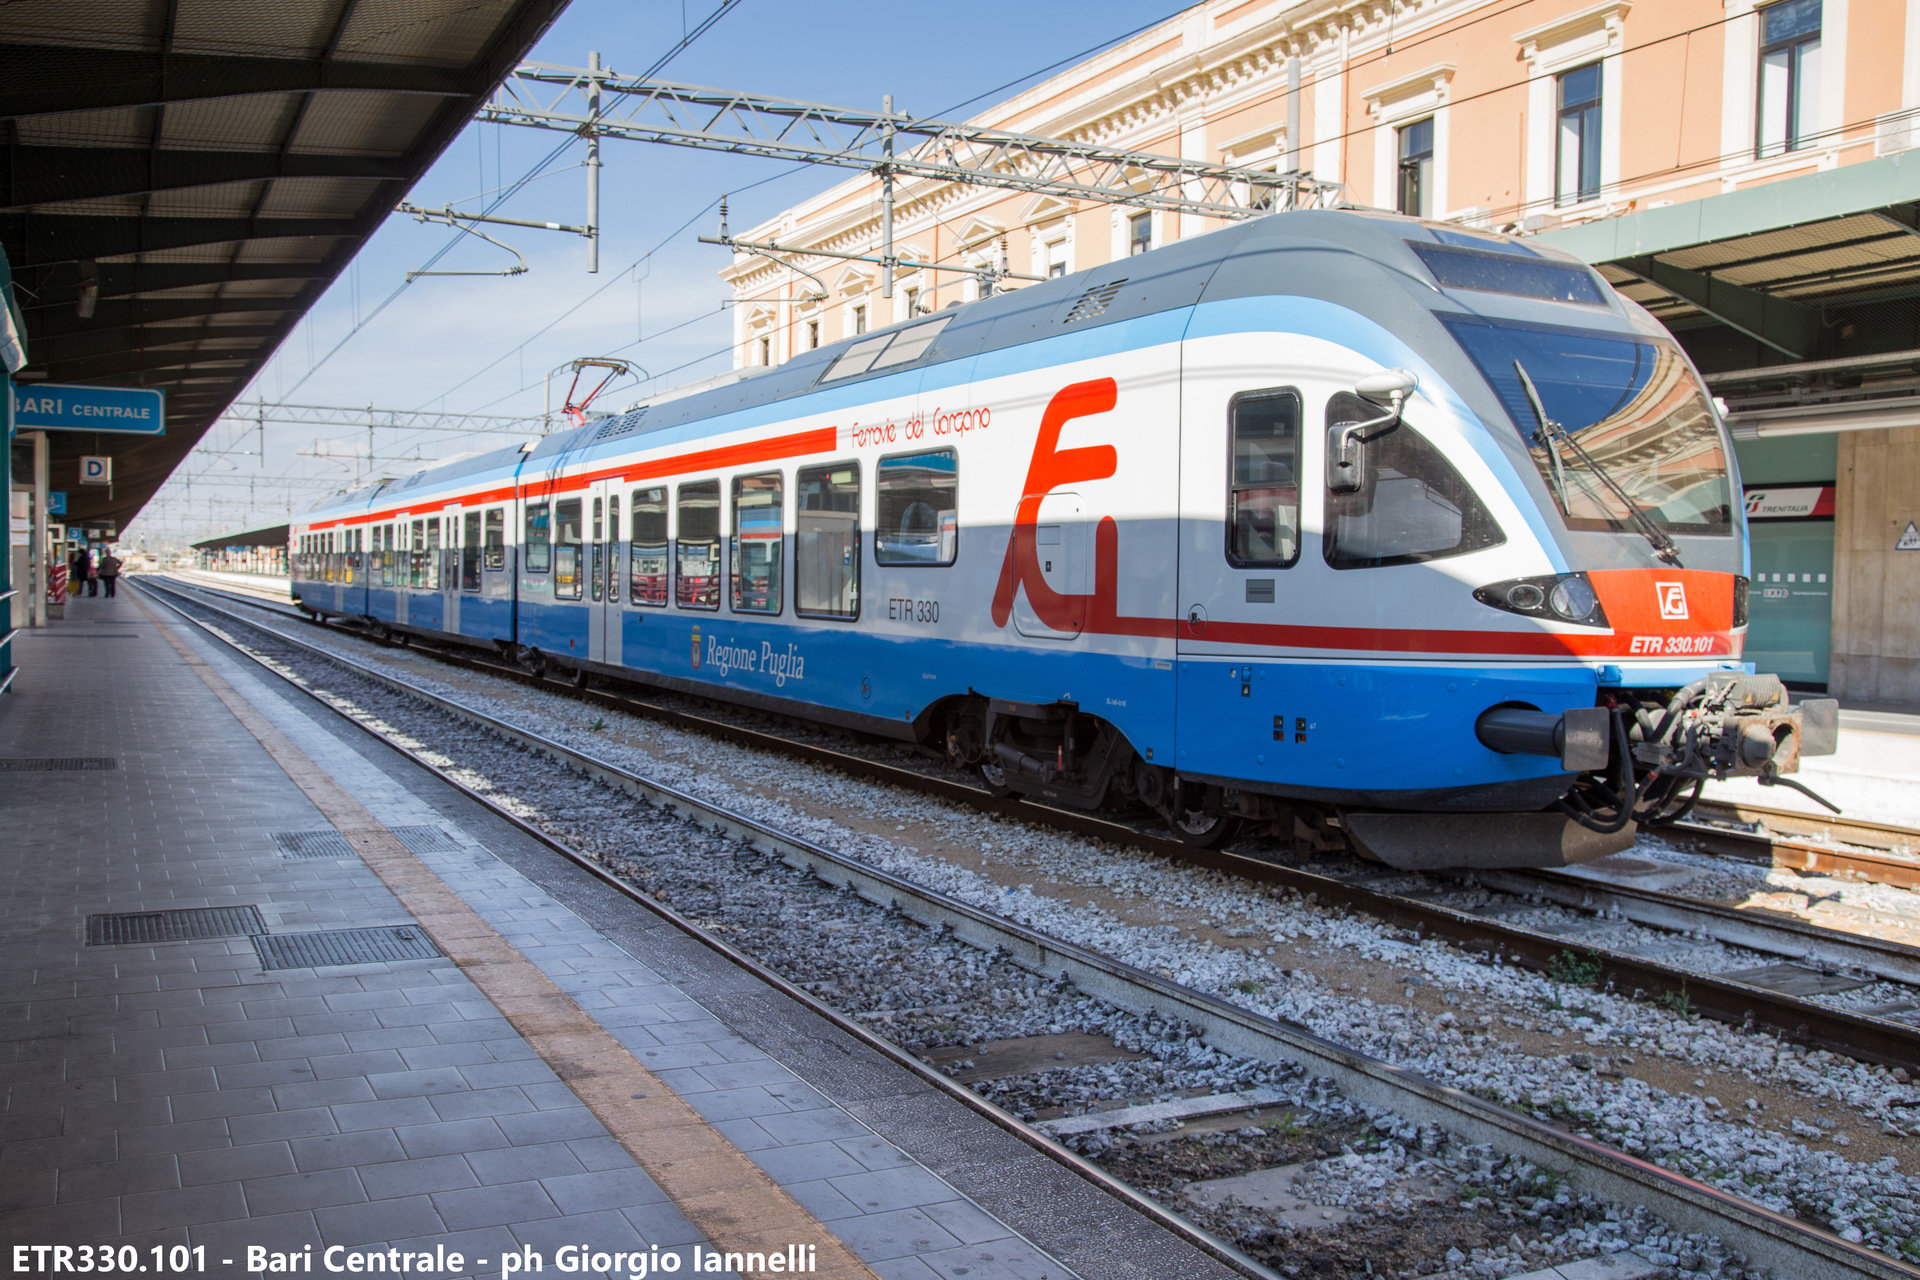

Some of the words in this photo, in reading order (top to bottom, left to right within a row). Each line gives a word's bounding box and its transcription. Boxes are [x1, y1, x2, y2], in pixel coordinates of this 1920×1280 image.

[72, 404, 150, 419] CENTRALE
[852, 417, 896, 448] Ferrovie
[905, 410, 924, 440] del
[933, 406, 990, 438] Gargano
[87, 461, 102, 476] D
[1762, 505, 1809, 513] TRENITALIA
[889, 598, 913, 622] ETR
[917, 600, 940, 623] 330
[1629, 636, 1663, 653] ETR
[1664, 636, 1714, 653] 330.101
[706, 635, 756, 677] Regione
[759, 641, 804, 687] Puglia
